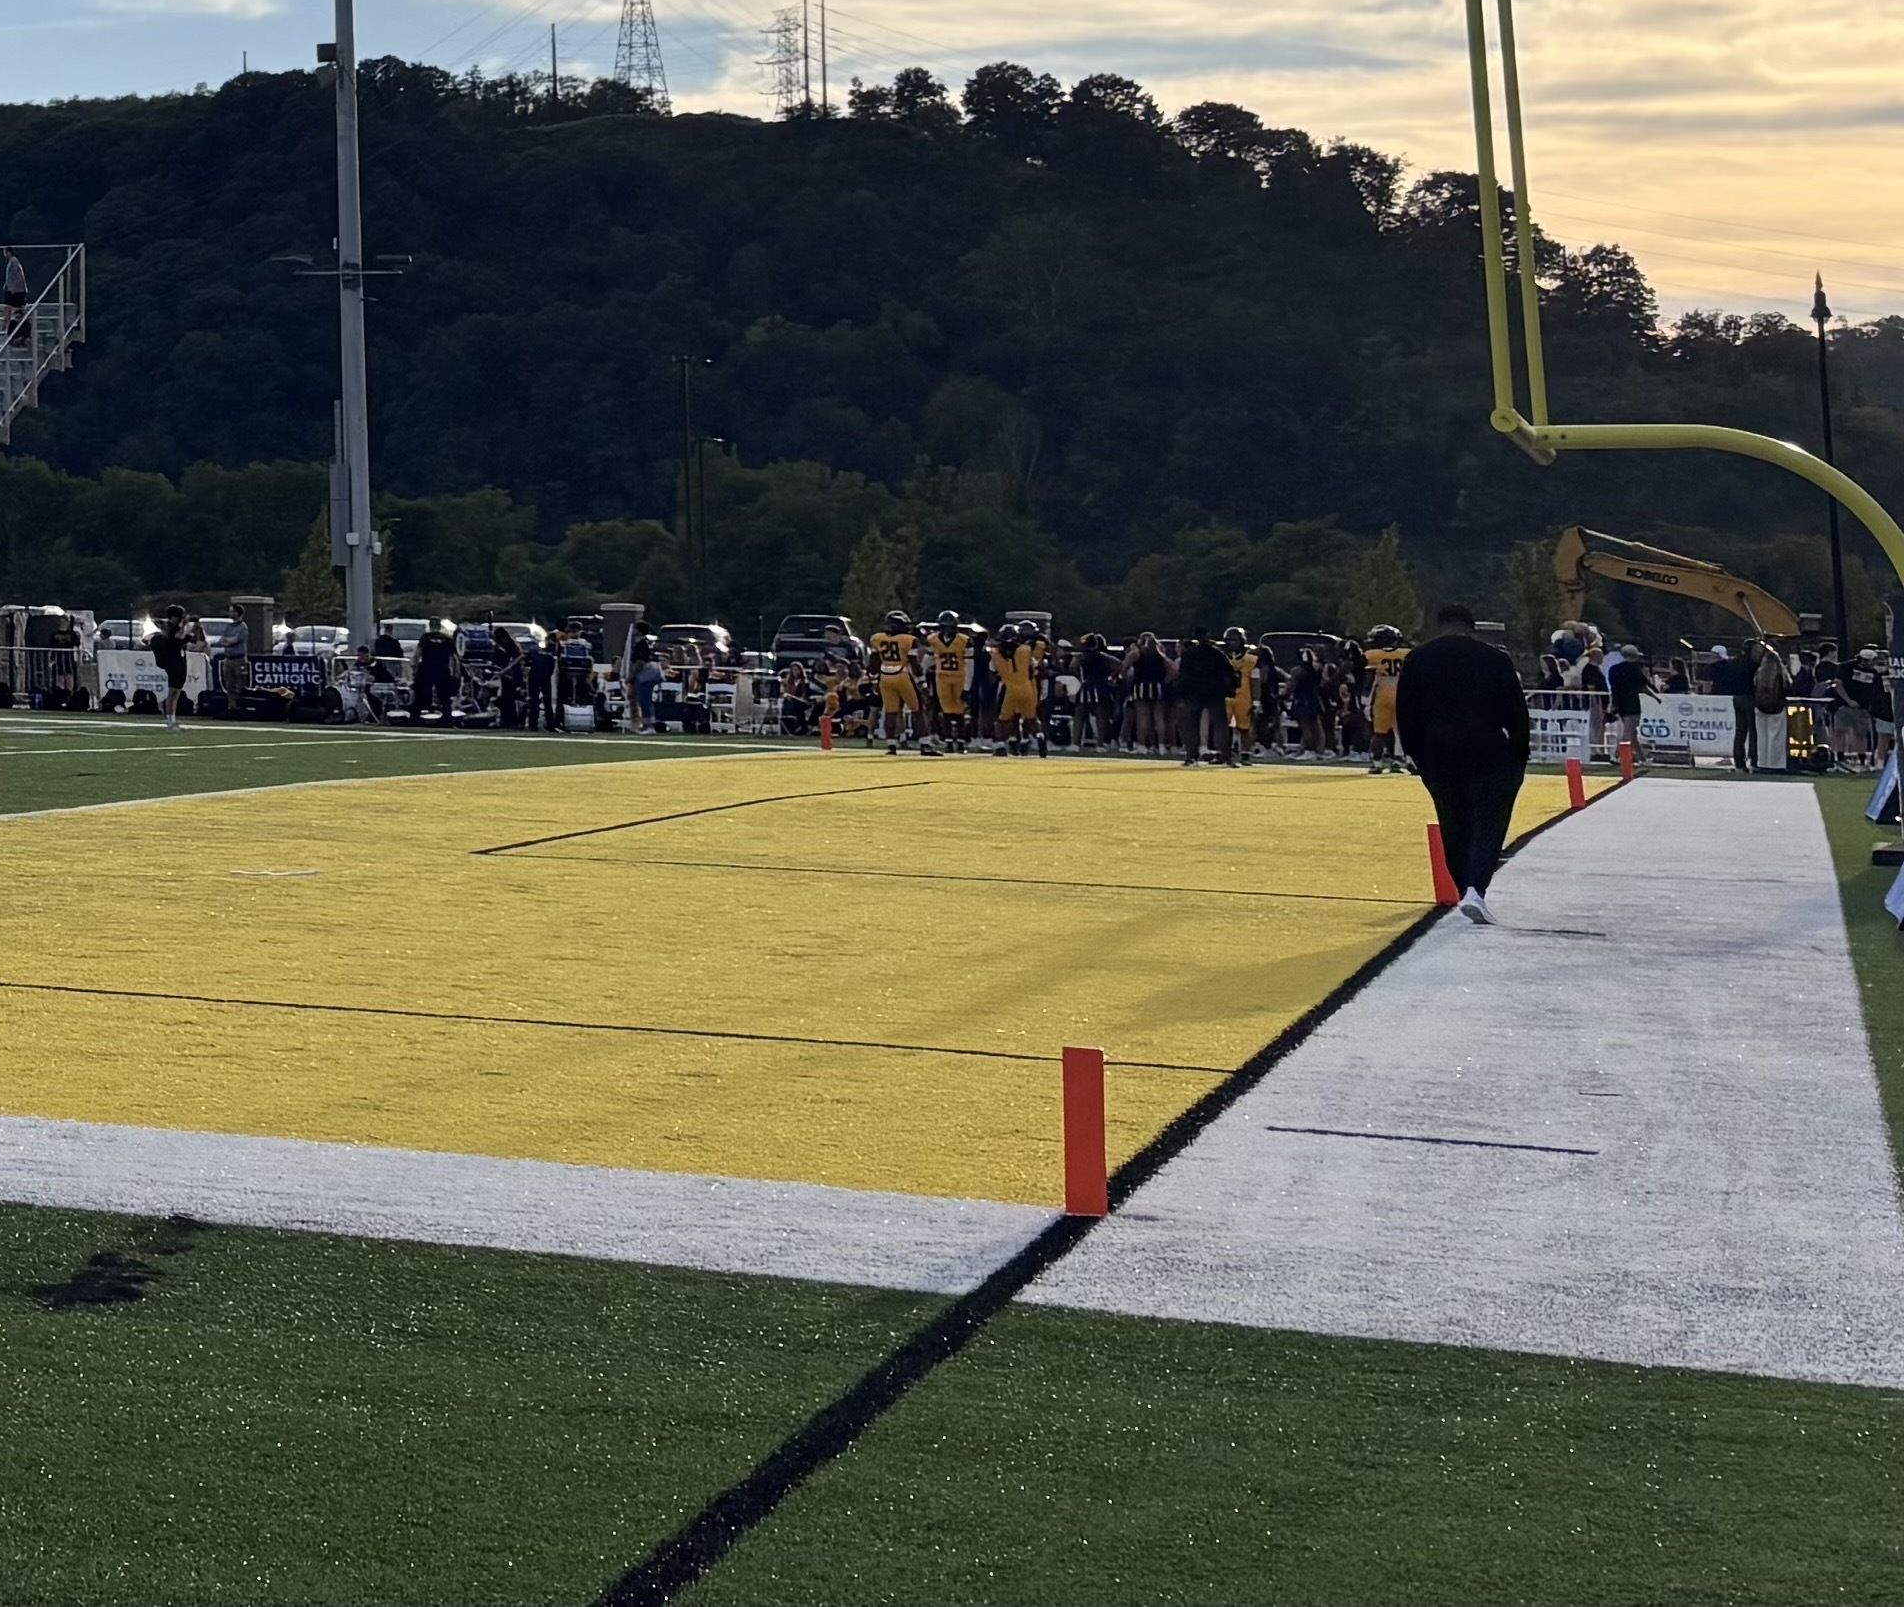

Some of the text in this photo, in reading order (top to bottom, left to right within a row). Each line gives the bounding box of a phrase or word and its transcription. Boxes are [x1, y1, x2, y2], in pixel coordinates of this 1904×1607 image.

[1626, 567, 1679, 585] KOBELCO
[878, 640, 899, 662] 28
[254, 661, 321, 674] CENTRAL
[254, 673, 322, 686] CATHOLIC
[1679, 720, 1733, 731] COMMU
[1680, 730, 1716, 741] FIELD
